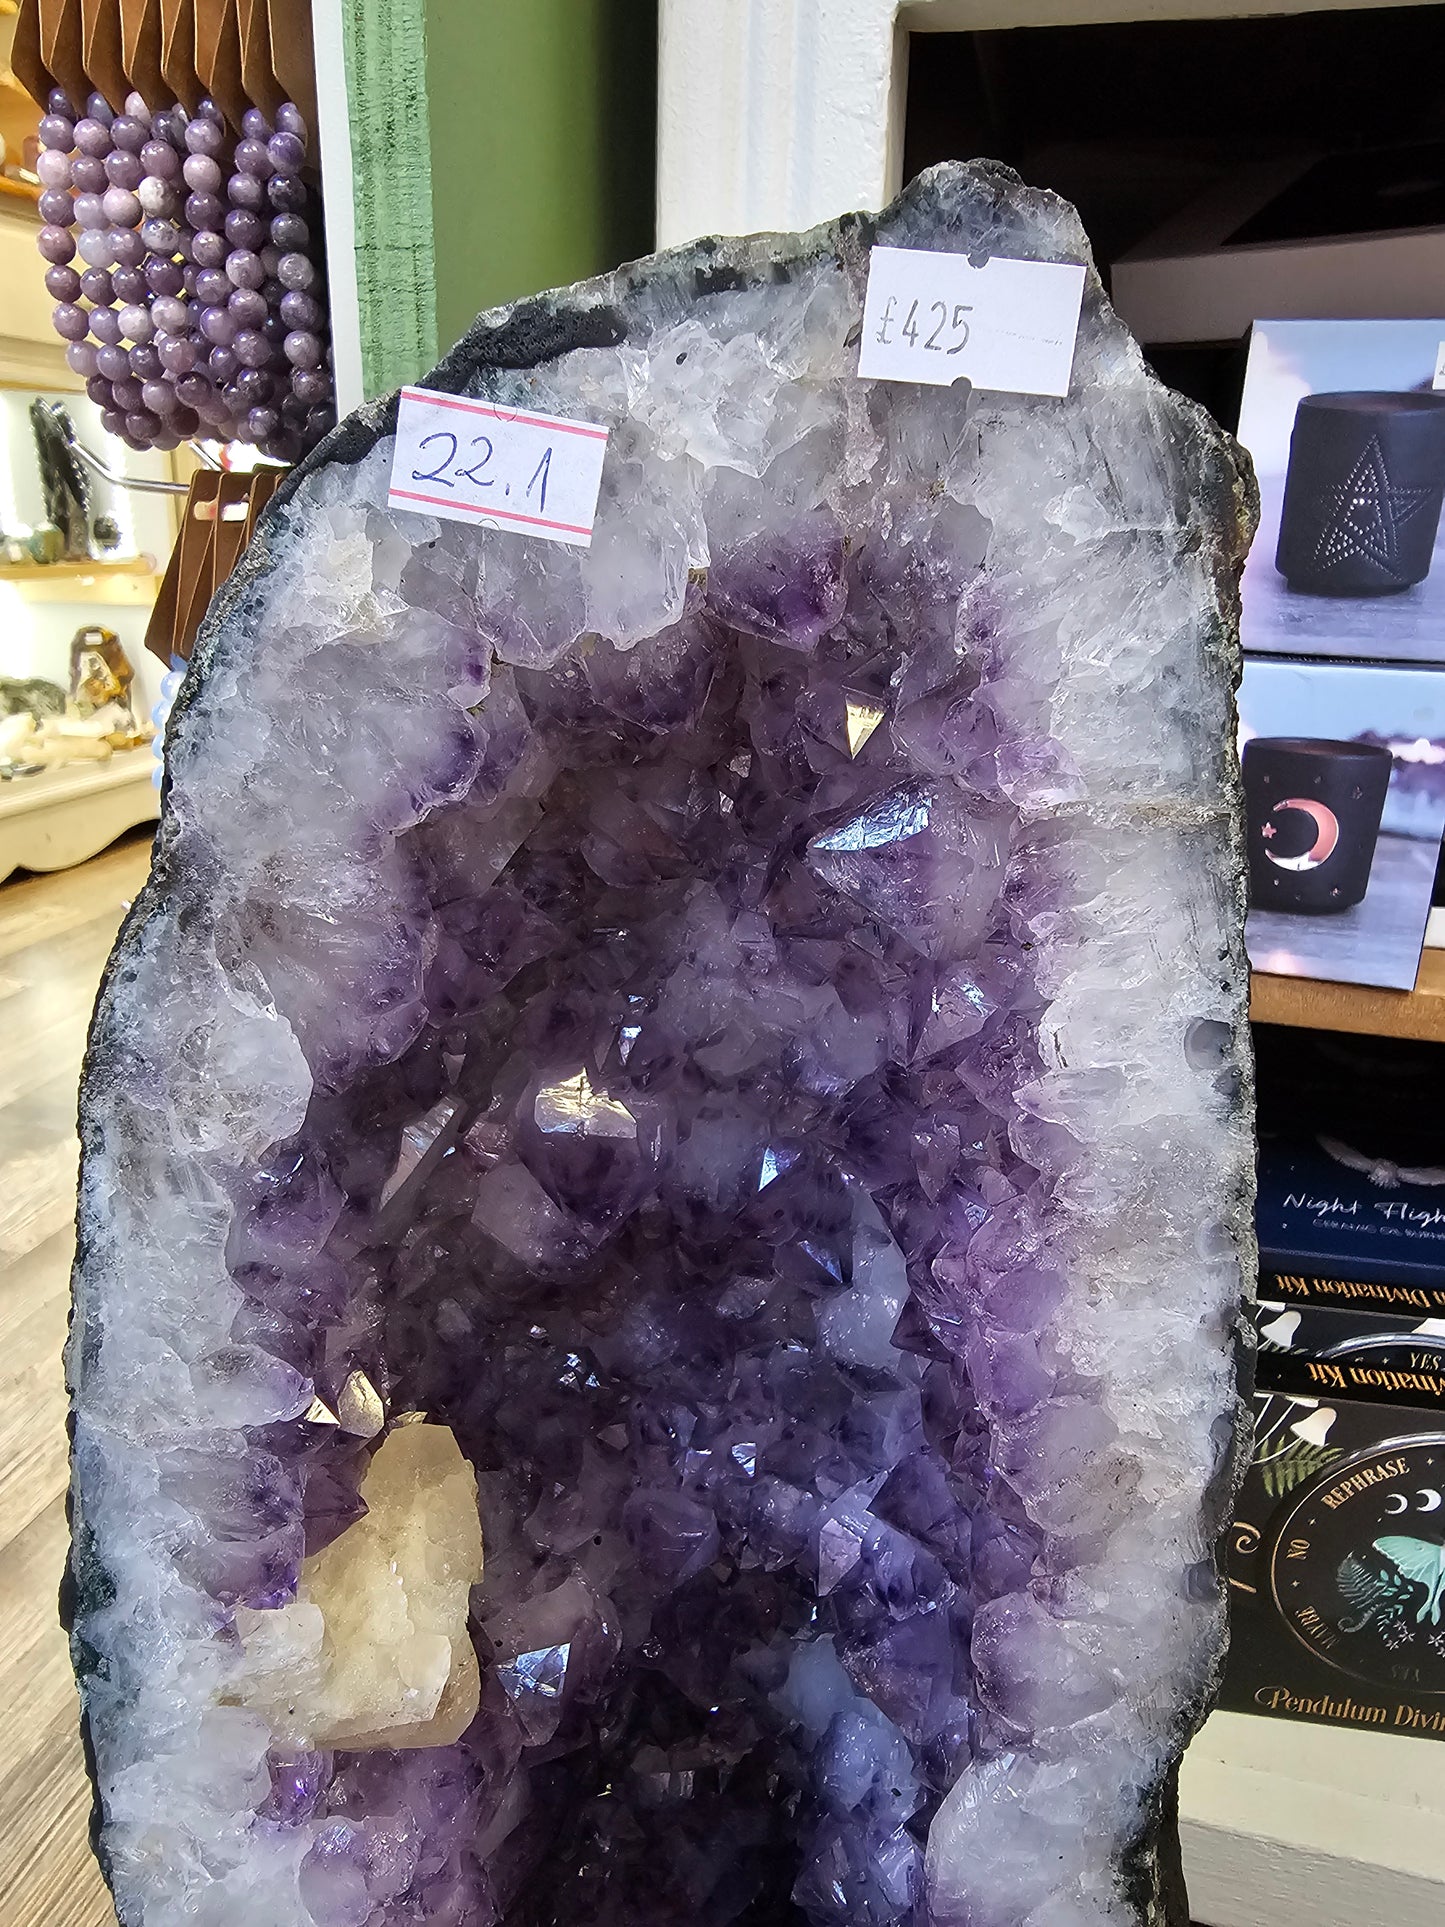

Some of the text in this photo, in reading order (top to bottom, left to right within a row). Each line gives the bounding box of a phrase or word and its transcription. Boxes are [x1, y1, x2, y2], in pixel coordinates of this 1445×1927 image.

[876, 296, 973, 354] £425
[411, 432, 553, 513] 22.1
[1282, 1193, 1361, 1217] Night
[1274, 1274, 1310, 1296] Kit
[1313, 1278, 1431, 1308] Divination
[1304, 1362, 1347, 1388] Kit
[1410, 1352, 1442, 1370] YES
[1320, 1456, 1412, 1510] REPHRASE
[1285, 1539, 1311, 1560] NO
[1255, 1685, 1387, 1723] Pendulum
